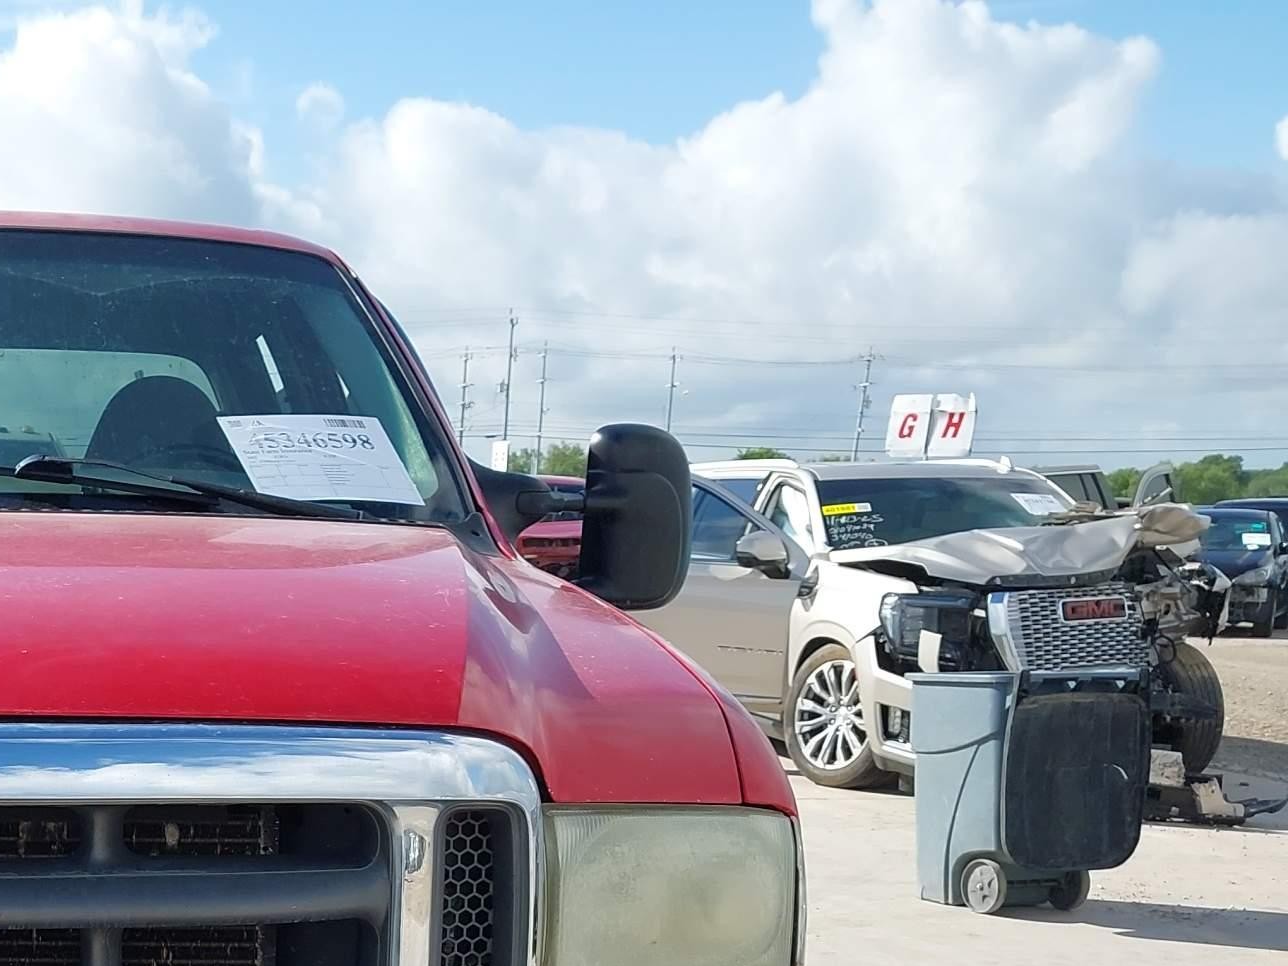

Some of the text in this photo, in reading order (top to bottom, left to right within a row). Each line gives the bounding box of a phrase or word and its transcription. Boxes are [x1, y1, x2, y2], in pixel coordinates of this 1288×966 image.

[898, 412, 919, 439] G
[940, 411, 966, 438] H
[248, 431, 376, 451] 45346598
[1064, 599, 1126, 620] GMC
